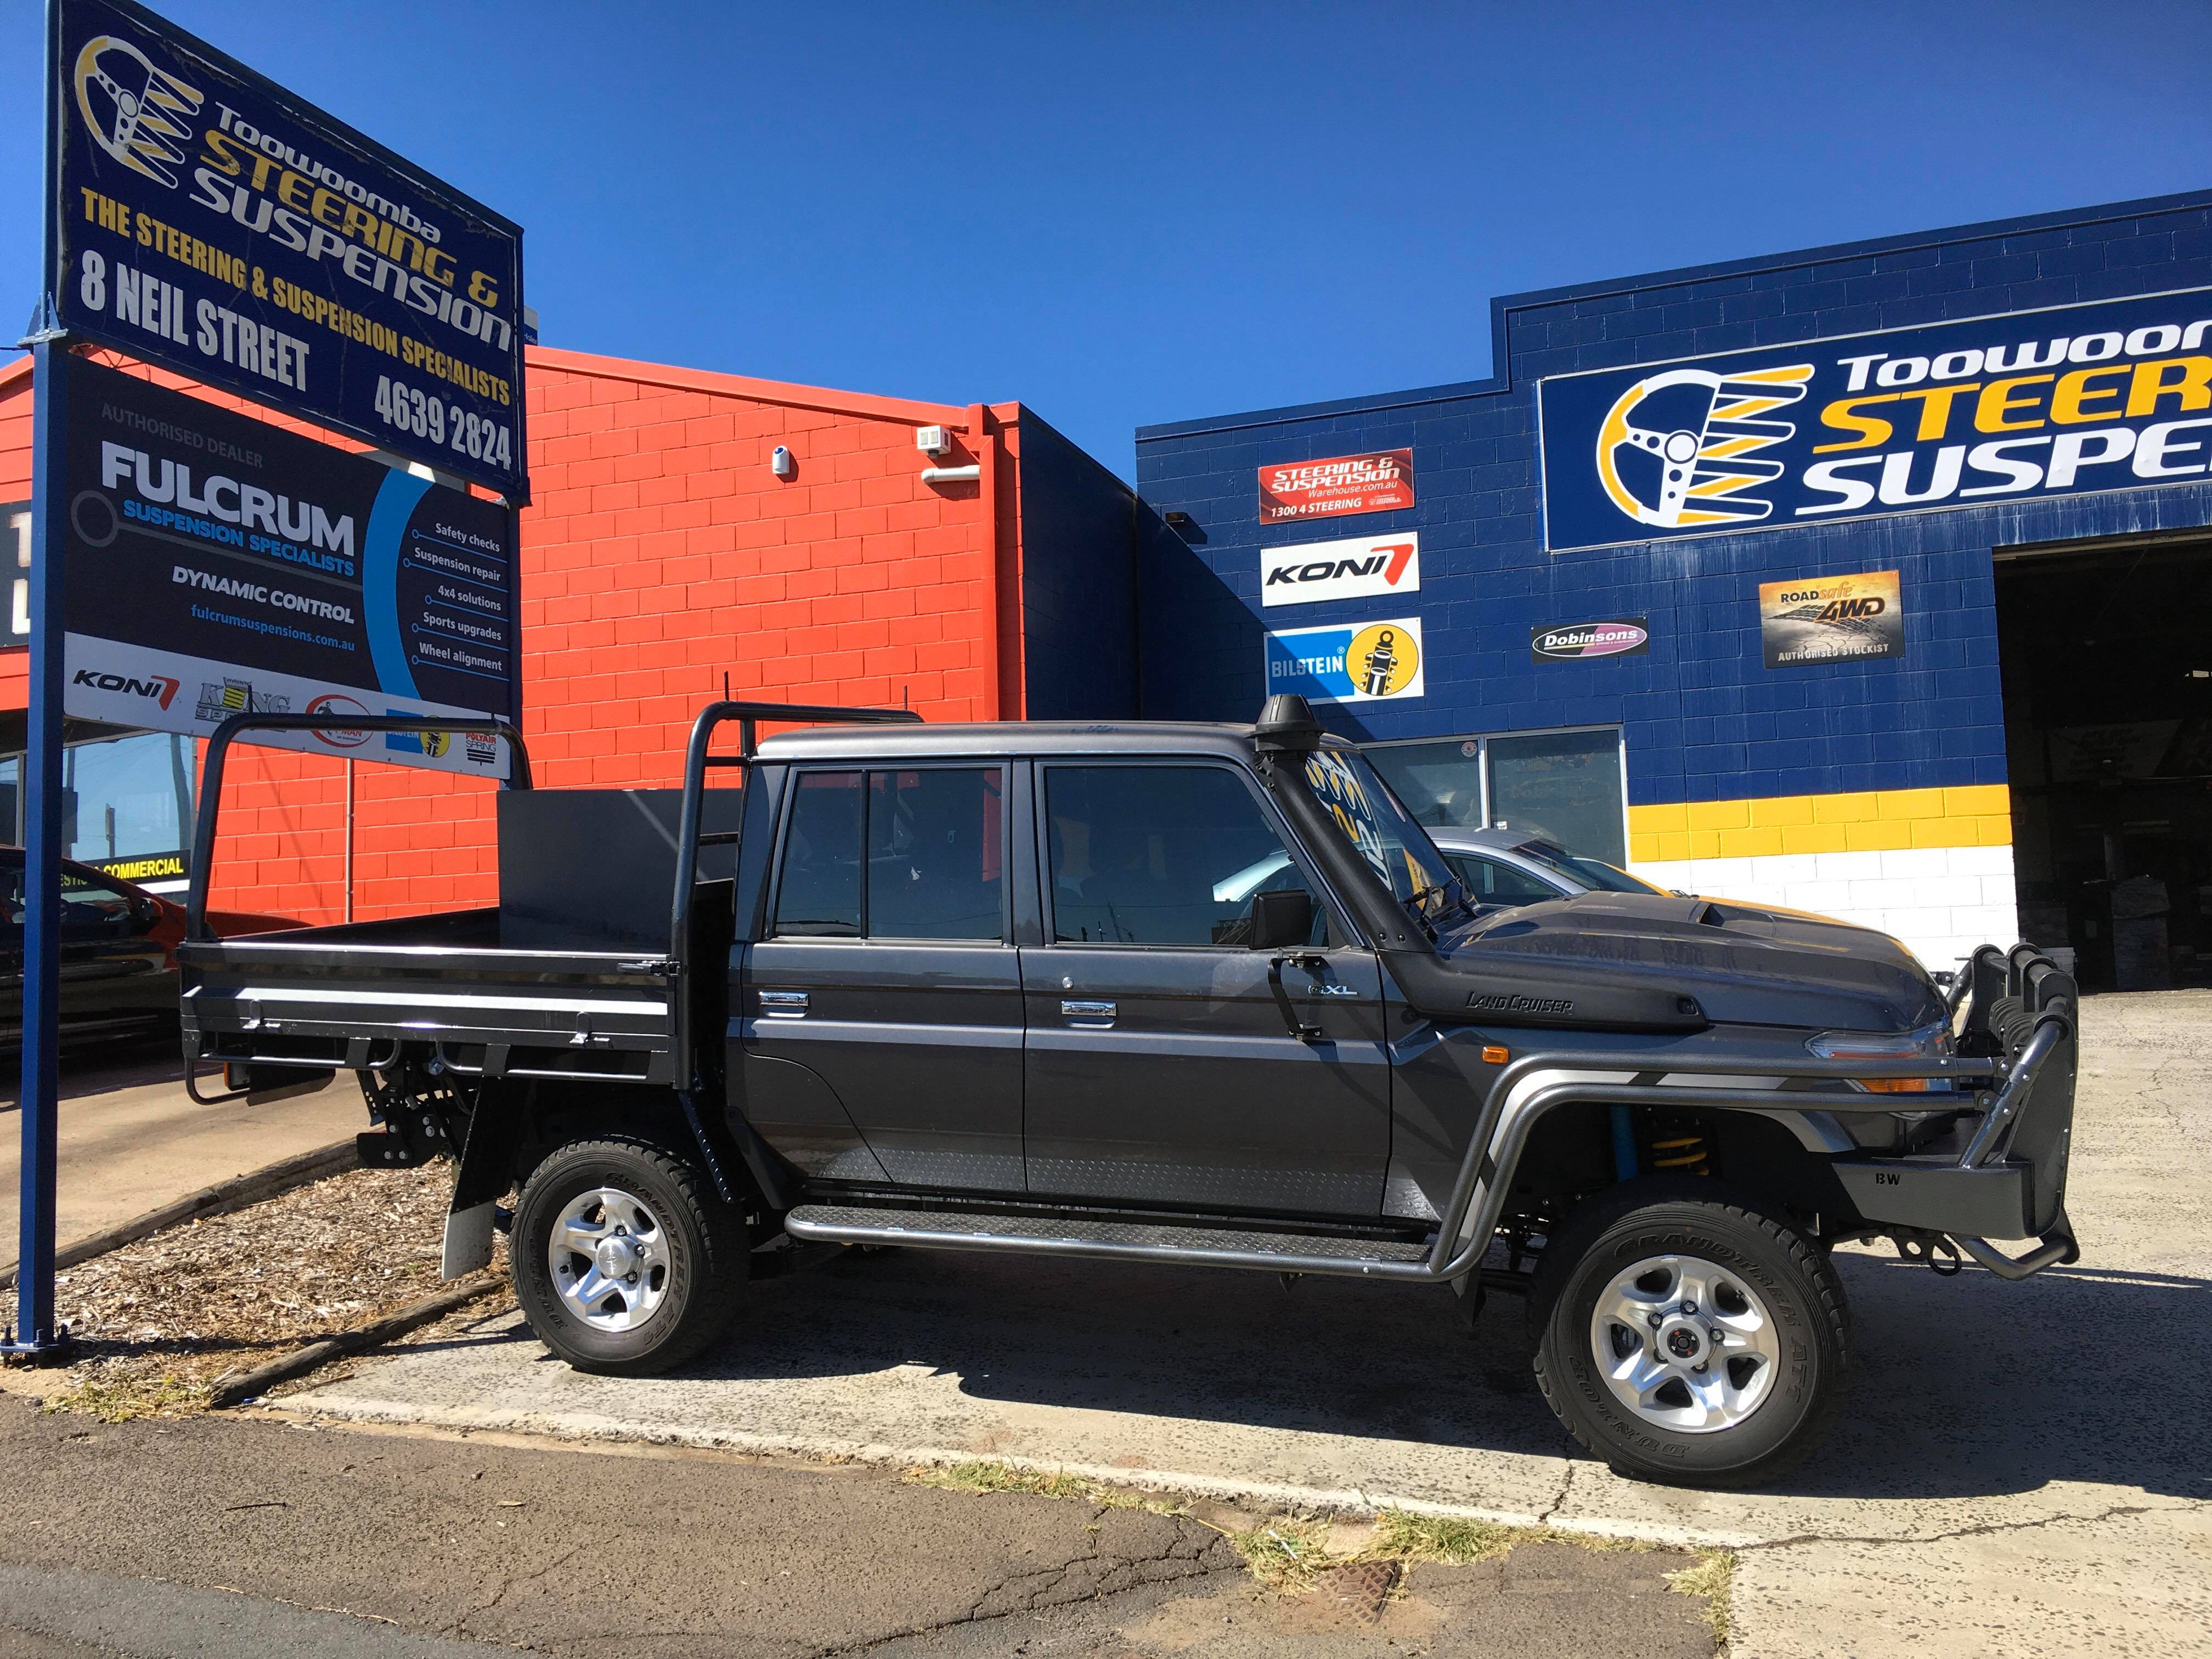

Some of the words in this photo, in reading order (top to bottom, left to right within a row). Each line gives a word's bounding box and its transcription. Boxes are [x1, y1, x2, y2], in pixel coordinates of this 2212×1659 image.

[201, 130, 458, 286] STEERING
[468, 271, 498, 308] &
[189, 167, 511, 352] SUSPENSION
[81, 186, 131, 238] THE
[136, 206, 246, 291] STEERING
[252, 267, 268, 300] &
[273, 277, 398, 357] SUSPENSION
[402, 336, 510, 406] SPECIALISTS
[81, 250, 105, 311] 8
[117, 263, 189, 347] NEIL
[197, 298, 309, 392] STREET
[101, 403, 203, 449] AUTHORISED
[207, 436, 263, 469] DEALER
[375, 375, 444, 444] 4639
[450, 405, 512, 471] 2824
[1270, 467, 1401, 494] SUSPENSION
[1274, 459, 1373, 483] STEERING
[1378, 457, 1393, 468] &
[1795, 418, 2212, 515] SUSPE
[101, 440, 354, 556] FULCRUM
[1308, 481, 1398, 498] Warehouse.com.au
[1271, 505, 1297, 517] 1300
[1299, 504, 1306, 514] 4
[1308, 498, 1362, 513] STEERING
[123, 499, 243, 548] SUSPENSION
[249, 533, 354, 577] SPECIALISTS
[436, 523, 467, 544] Safety
[469, 534, 500, 552] checks
[415, 547, 470, 573] Suspension
[472, 565, 500, 582] repair
[1266, 555, 1387, 586] KONI
[172, 566, 267, 605] DYNAMIC
[270, 591, 354, 625] CONTROL
[438, 585, 456, 599] 4x4
[458, 592, 501, 611] solutions
[1814, 597, 1885, 623] 4WD
[191, 604, 355, 652] fulcrumsuspensions.com.au
[424, 611, 455, 629] Sports
[458, 623, 501, 641] upgrades
[1544, 630, 1638, 646] Dobinsons
[419, 642, 450, 659] Wheel
[453, 650, 502, 671] alignment
[1272, 656, 1343, 678] BILSTEIN
[1778, 649, 1838, 662] AUTHORISED
[1842, 644, 1889, 656] STOCKIST
[72, 669, 161, 698] KONI
[466, 733, 496, 744] POLYAIR
[466, 740, 496, 752] SPRING
[1876, 1173, 1900, 1186] BW
[1570, 1356, 1690, 1458] DUNLOP
